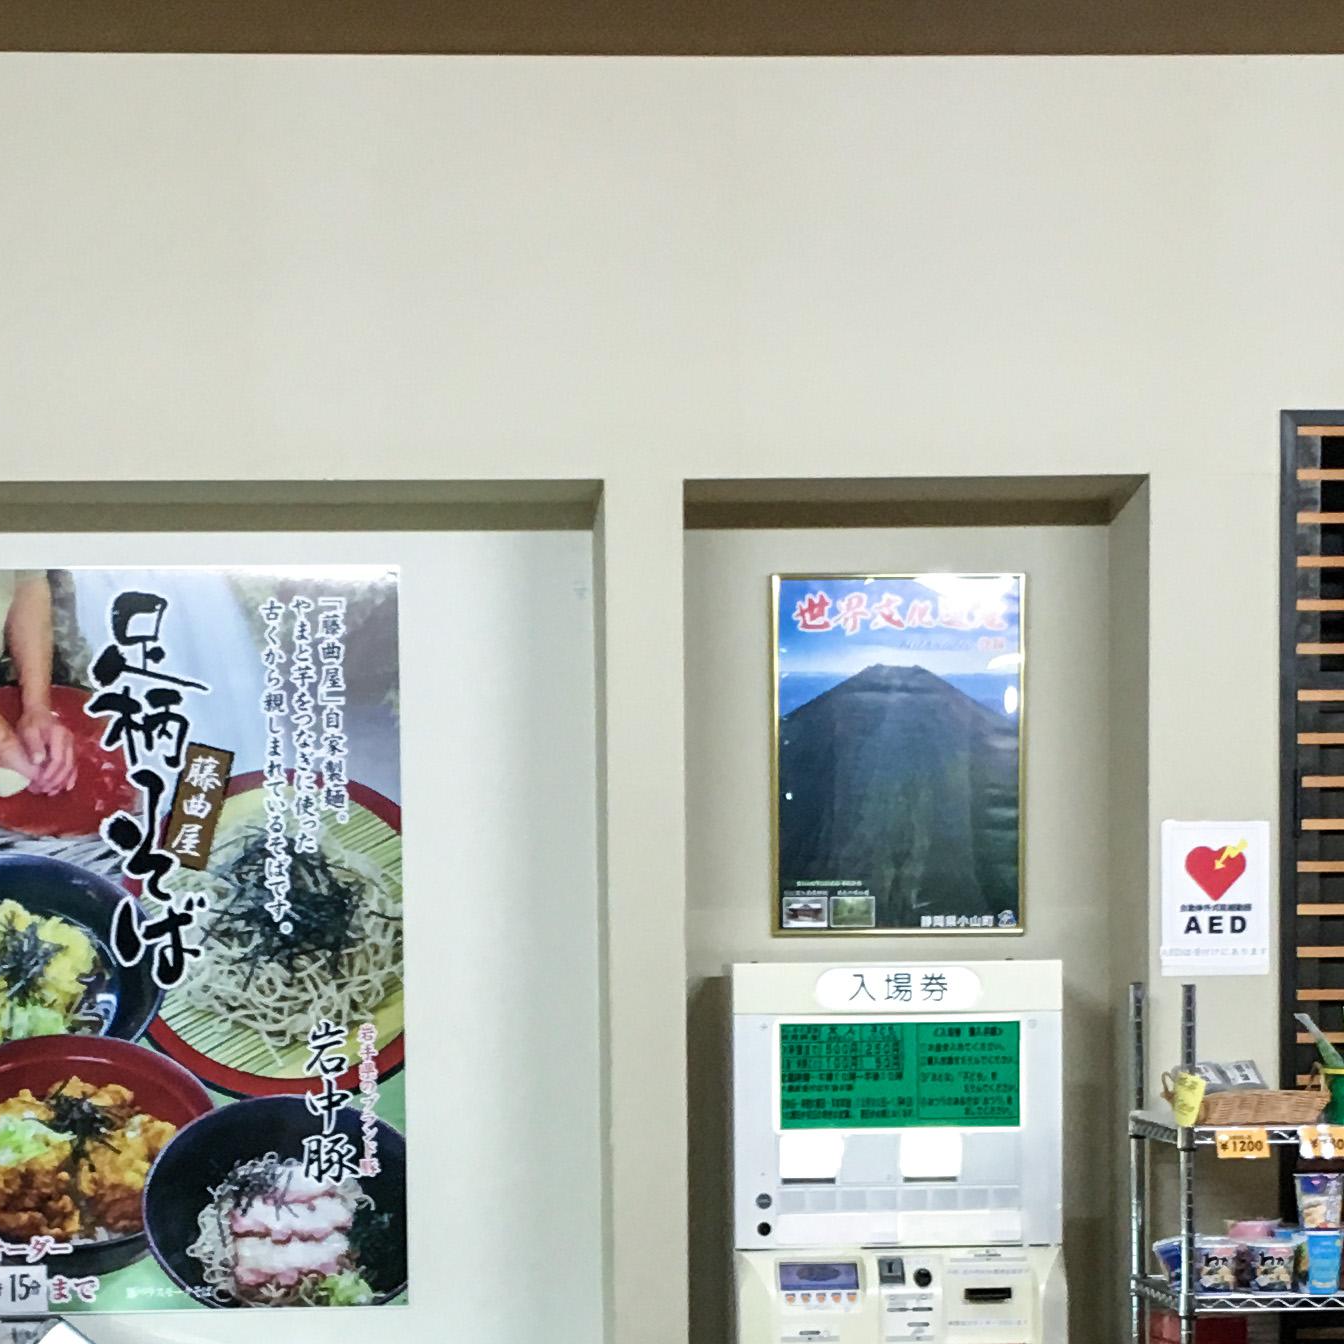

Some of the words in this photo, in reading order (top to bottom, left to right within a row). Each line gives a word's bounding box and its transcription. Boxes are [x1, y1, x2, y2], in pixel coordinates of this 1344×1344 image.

[289, 596, 318, 853] やまと芋をつなぎに使った
[259, 597, 293, 934] 古くから親しまれているそばです。
[171, 755, 222, 858] 藤曲屋
[1184, 916, 1246, 934] AED
[849, 974, 948, 1001] 入場券
[303, 1021, 360, 1184] 岩中豚
[1220, 1140, 1263, 1152] ¥1200
[50, 1275, 99, 1302] まで
